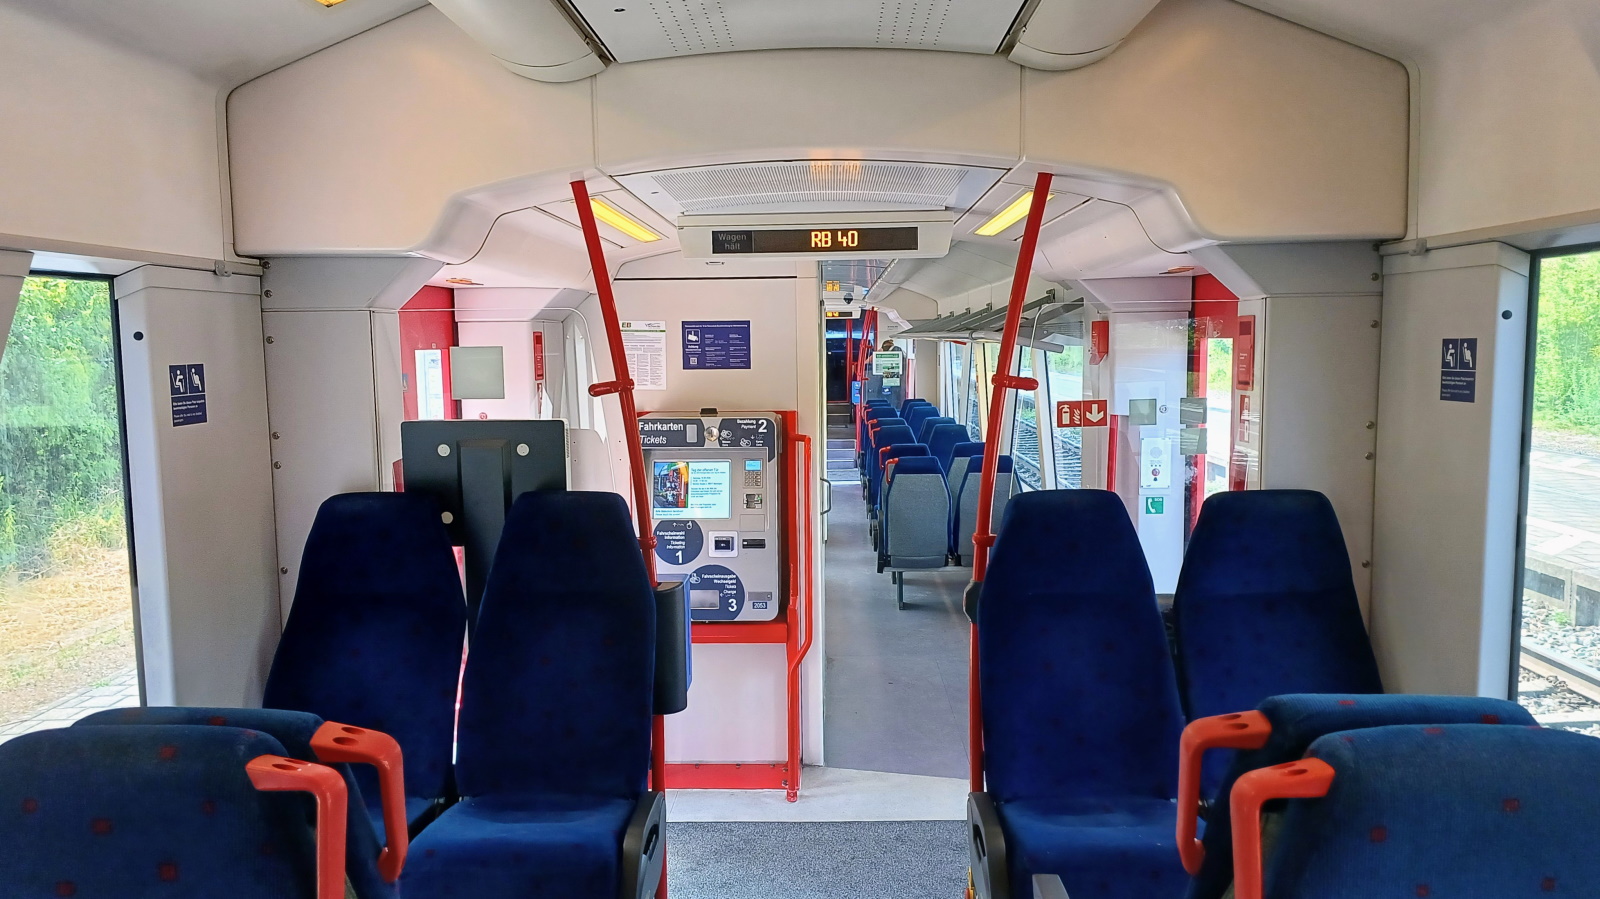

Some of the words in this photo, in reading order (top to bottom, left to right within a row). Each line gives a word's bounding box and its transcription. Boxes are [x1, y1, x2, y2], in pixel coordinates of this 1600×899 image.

[718, 233, 747, 242] Wagen
[811, 231, 832, 248] RB
[837, 230, 858, 247] 40
[638, 422, 684, 431] Fahrkarten
[758, 419, 768, 433] 2
[640, 435, 667, 444] Tickets
[675, 550, 683, 564] 1
[728, 598, 738, 612] 3
